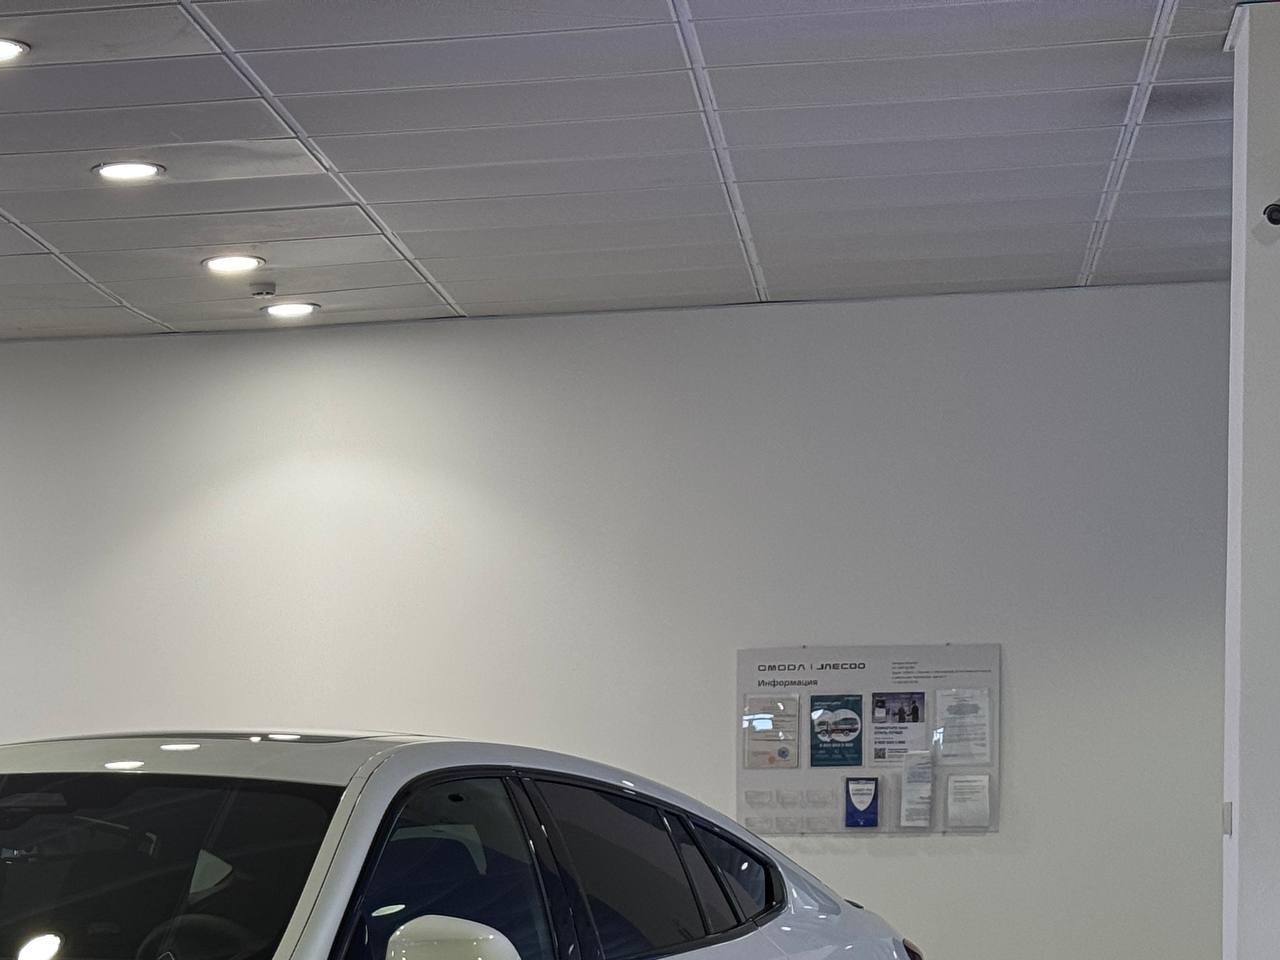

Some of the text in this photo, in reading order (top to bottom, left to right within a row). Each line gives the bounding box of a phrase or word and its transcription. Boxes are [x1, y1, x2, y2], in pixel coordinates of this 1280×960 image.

[757, 662, 866, 672] OMODA JAECOO
[757, 678, 818, 689] Информация
